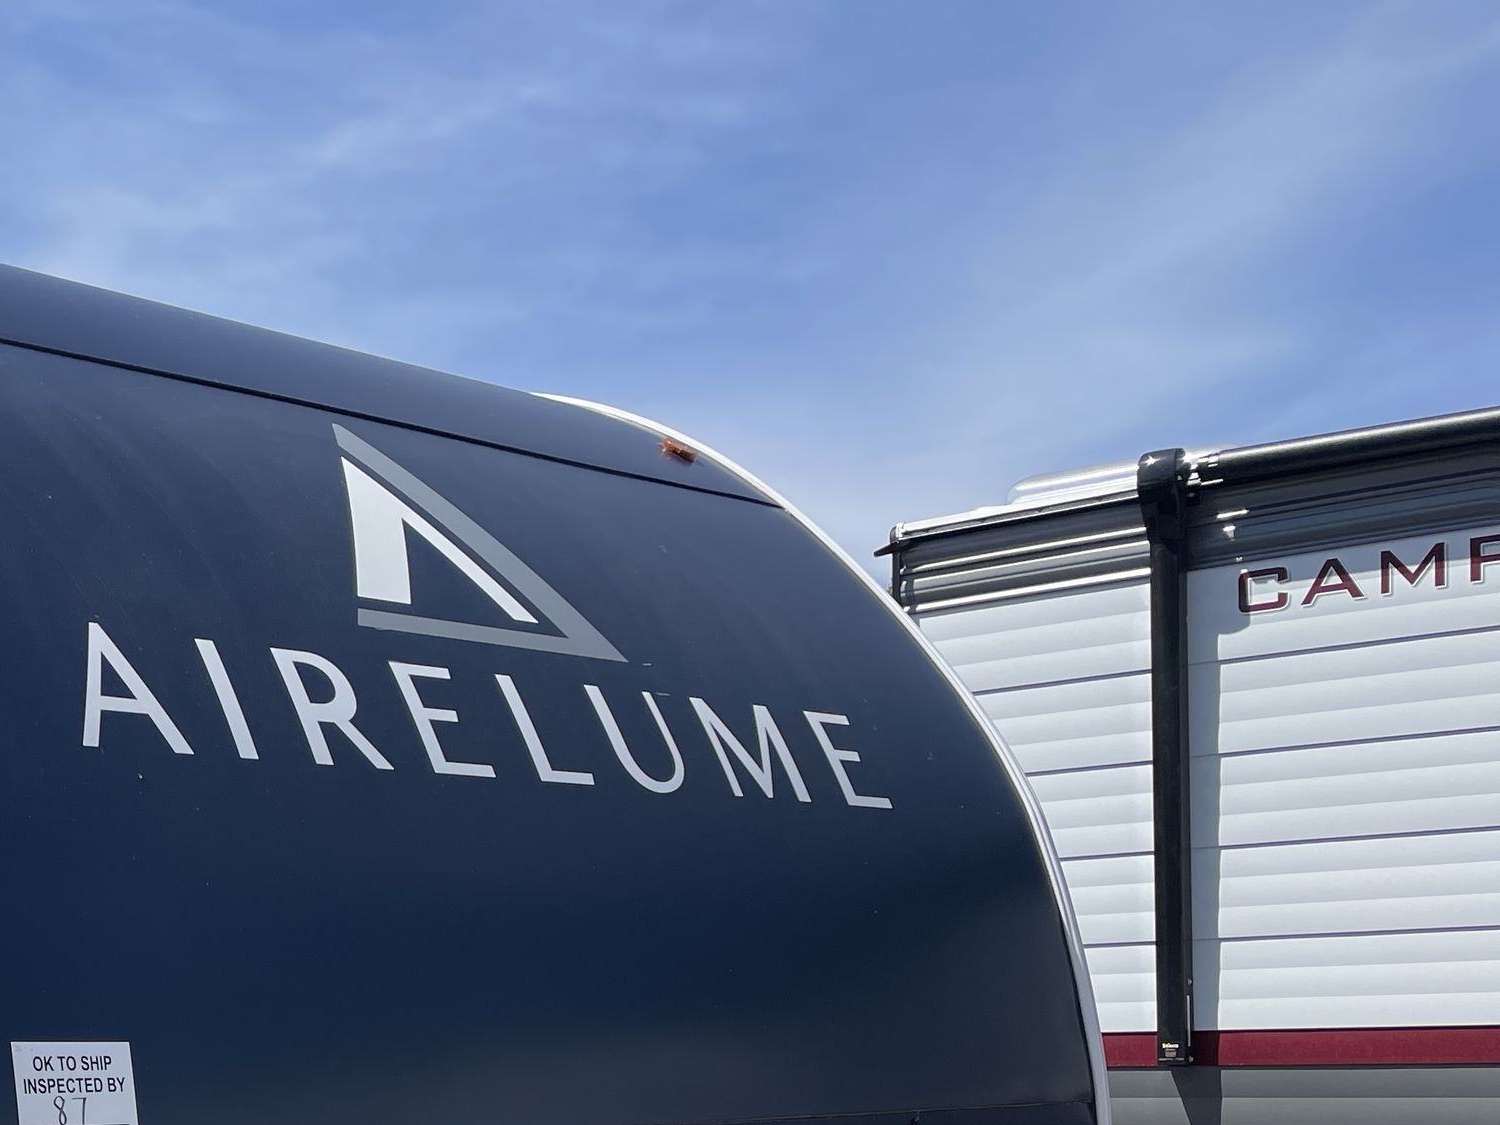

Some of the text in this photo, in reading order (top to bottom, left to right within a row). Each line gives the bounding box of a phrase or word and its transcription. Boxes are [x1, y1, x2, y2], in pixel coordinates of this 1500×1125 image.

[81, 621, 893, 810] AIRELUME
[32, 1055, 112, 1072] OK TO SHIP
[23, 1076, 125, 1094] INSPECTED BY
[53, 1095, 87, 1125] 87
